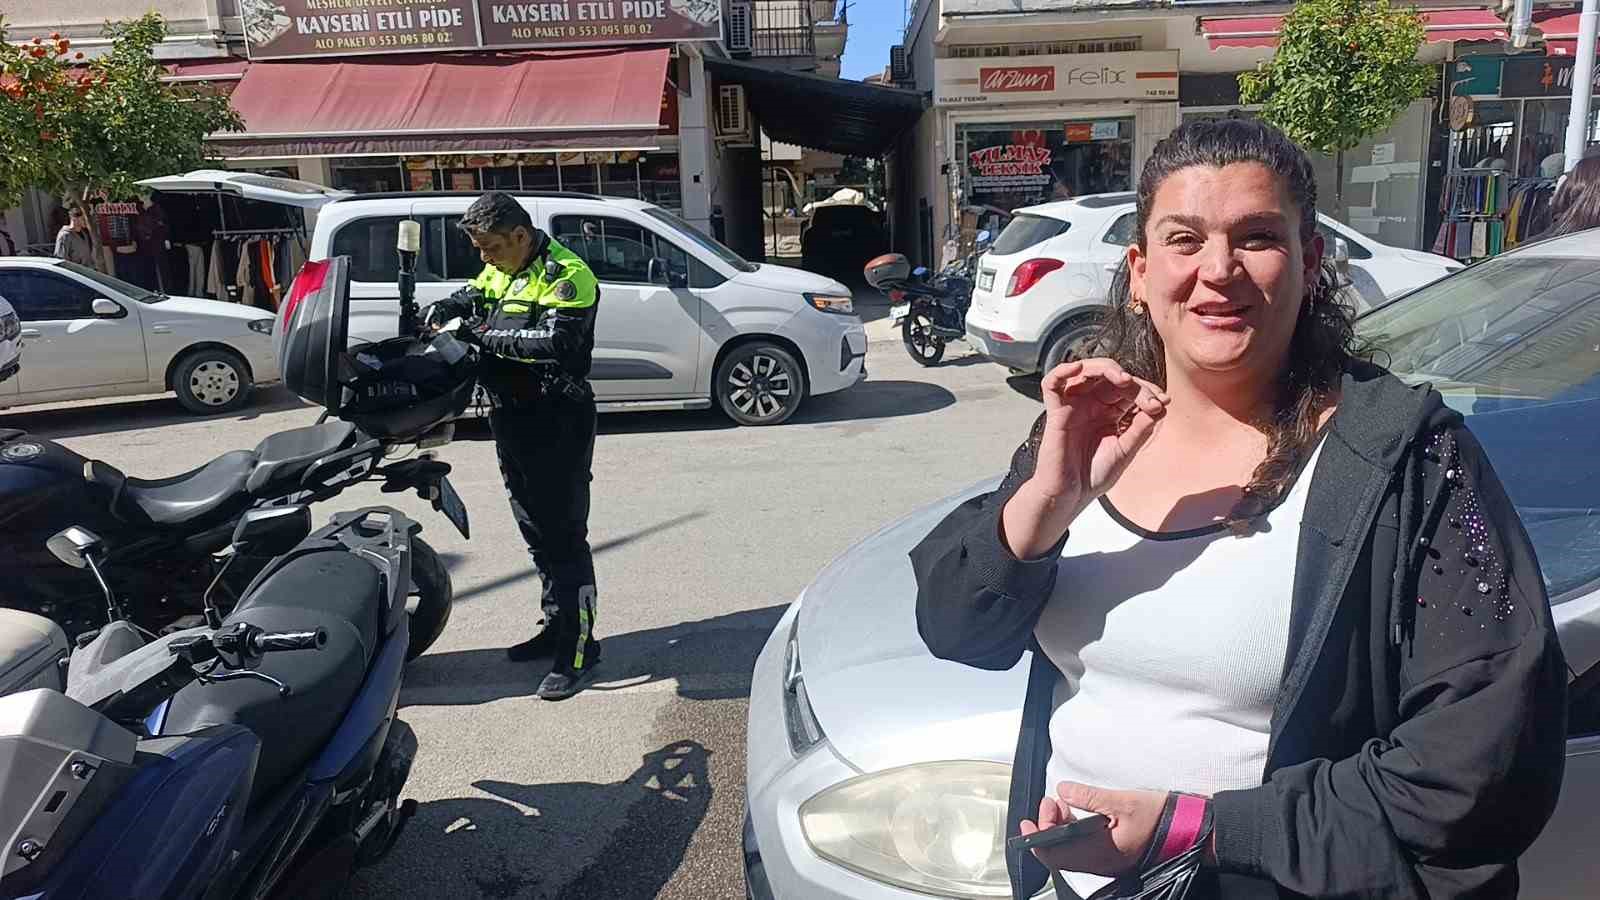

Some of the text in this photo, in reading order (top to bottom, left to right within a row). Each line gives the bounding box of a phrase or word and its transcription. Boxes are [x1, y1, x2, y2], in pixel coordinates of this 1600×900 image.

[296, 5, 464, 34] KAYSERİ ETLİ PİDE
[492, 0, 571, 24] KAYSERİ
[315, 38, 334, 49] ALO
[337, 37, 367, 49] PAKET
[369, 37, 376, 47] 0
[379, 35, 398, 46] 553
[400, 34, 418, 45] 095
[422, 33, 434, 44] 80
[511, 24, 653, 39] ALO PAKET 0 553 095 80 02
[968, 144, 1052, 169] YILMAZ
